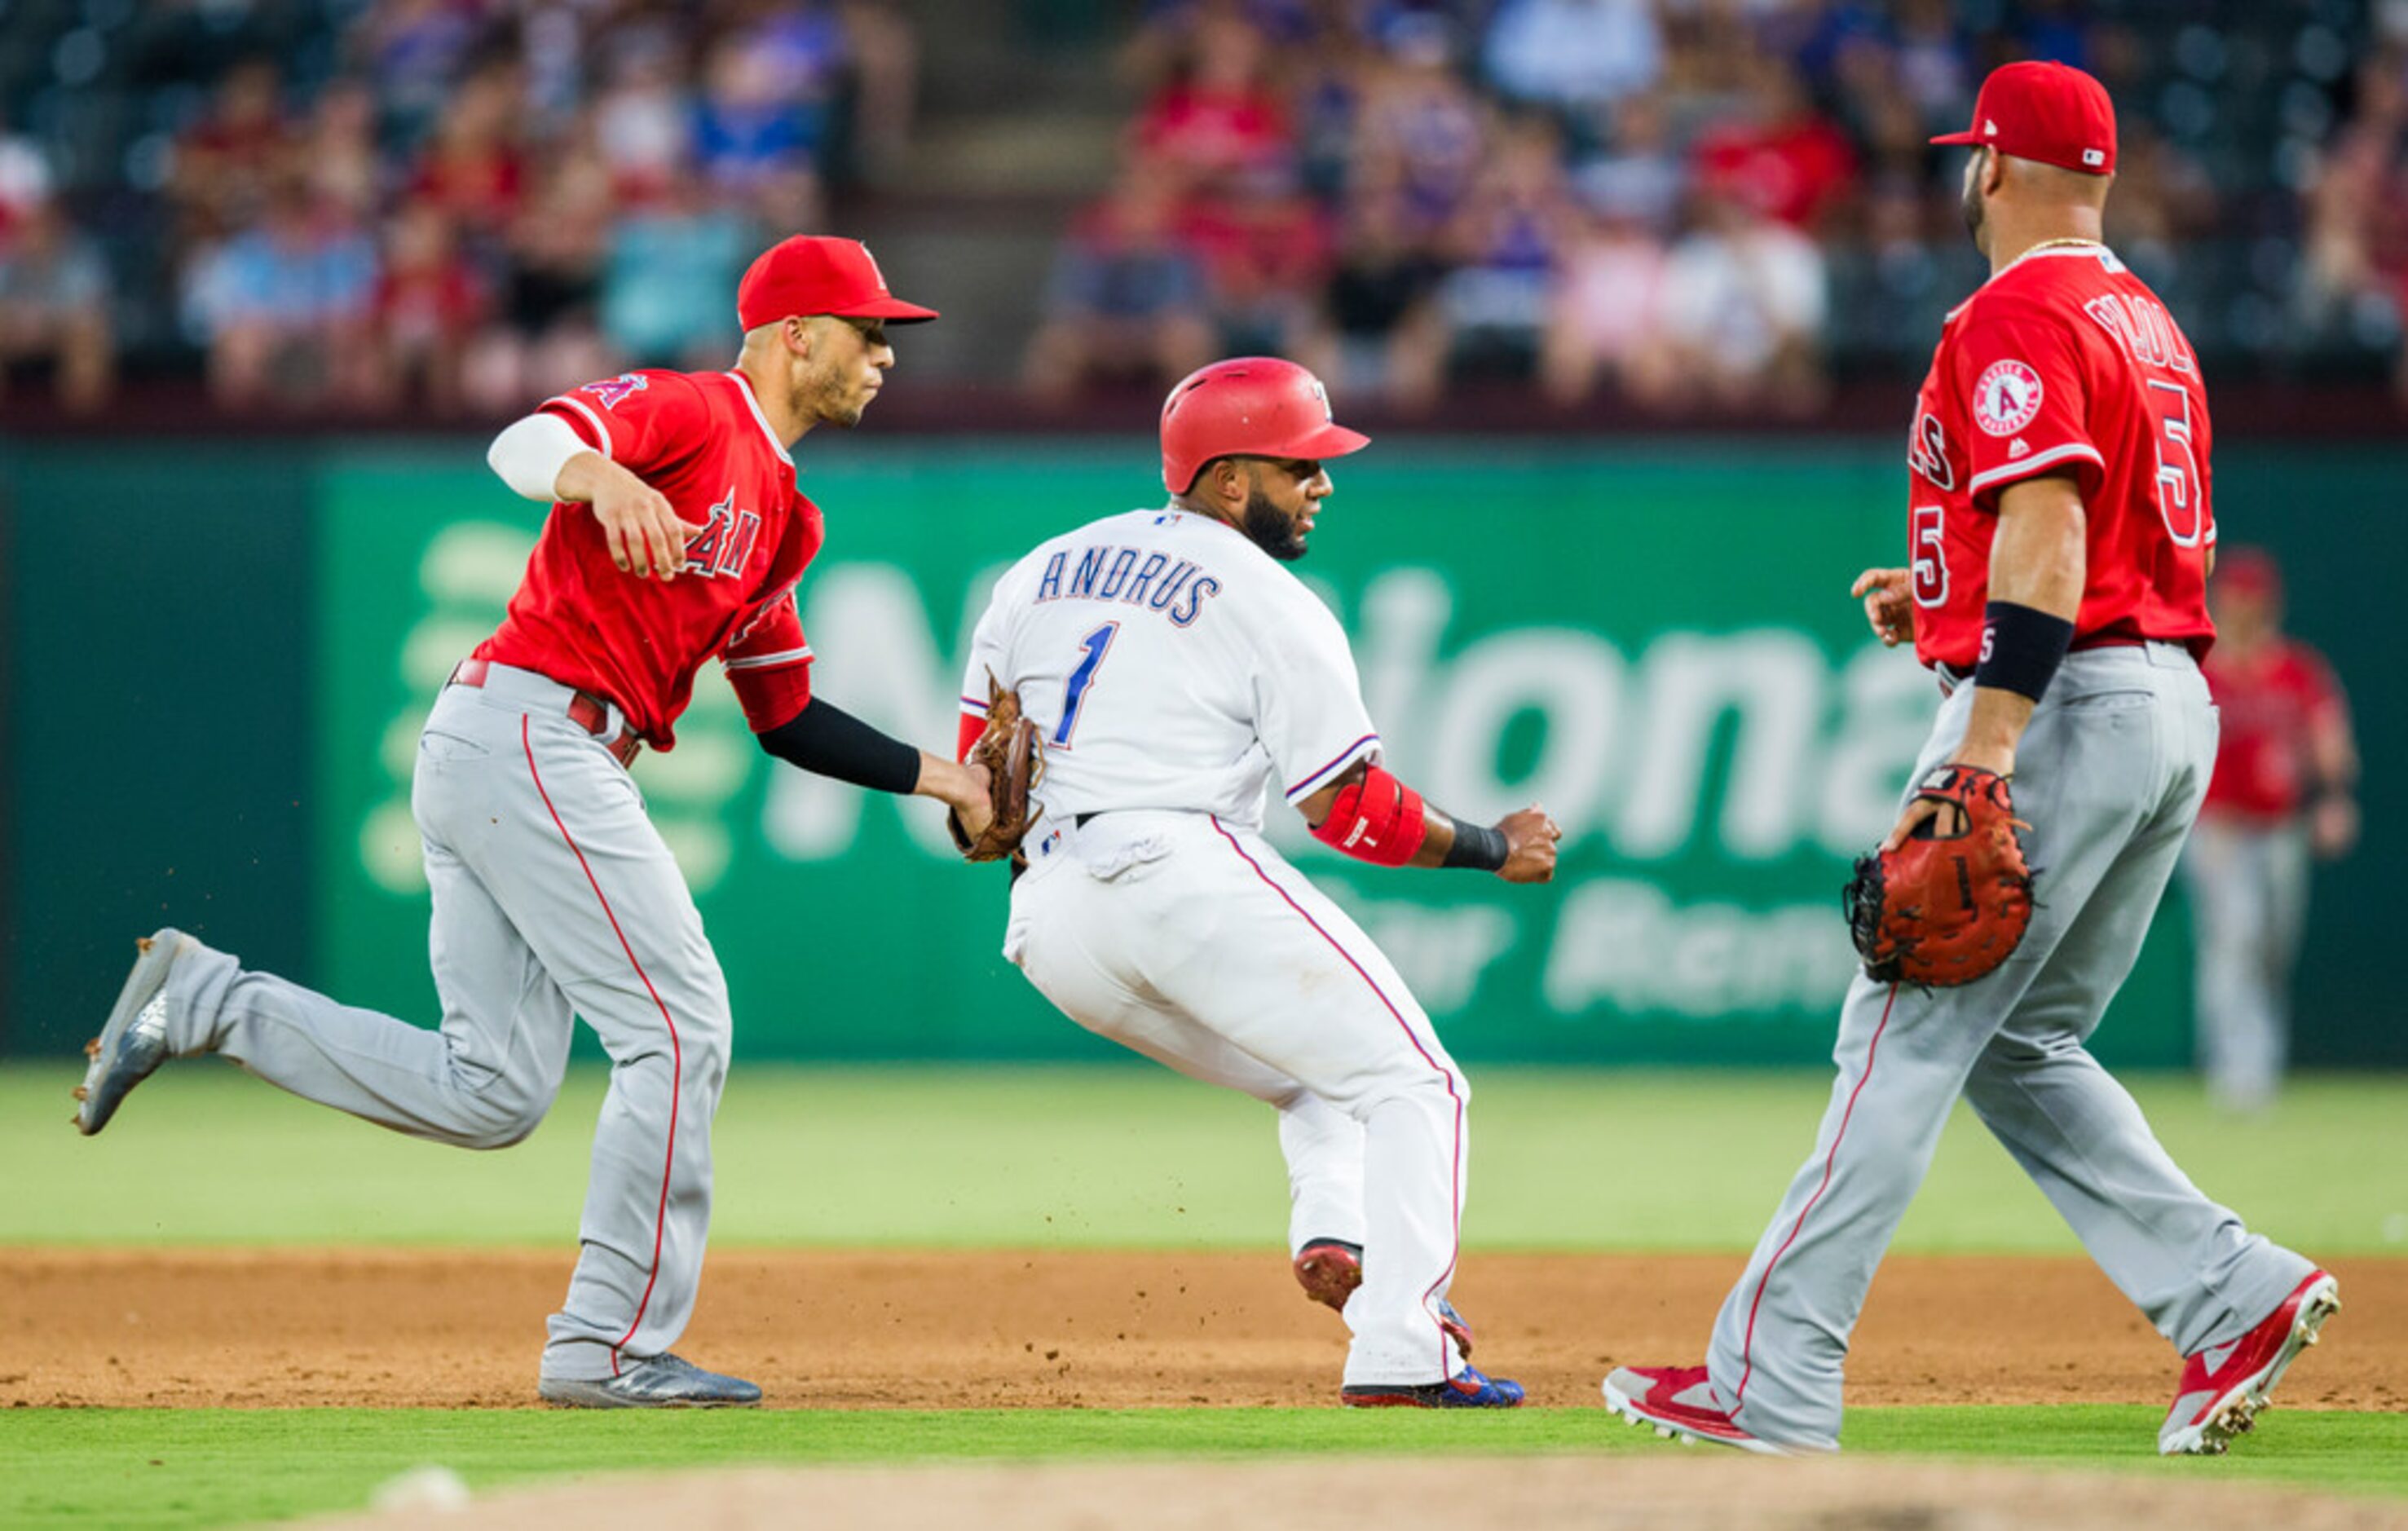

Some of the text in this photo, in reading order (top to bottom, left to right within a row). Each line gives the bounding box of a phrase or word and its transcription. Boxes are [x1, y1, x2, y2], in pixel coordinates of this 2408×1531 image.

[1997, 377, 2019, 418] A
[2147, 377, 2202, 549] 5
[1033, 545, 1223, 628] ANDRUS
[1912, 505, 1951, 608] 5
[1048, 620, 1120, 751] 1
